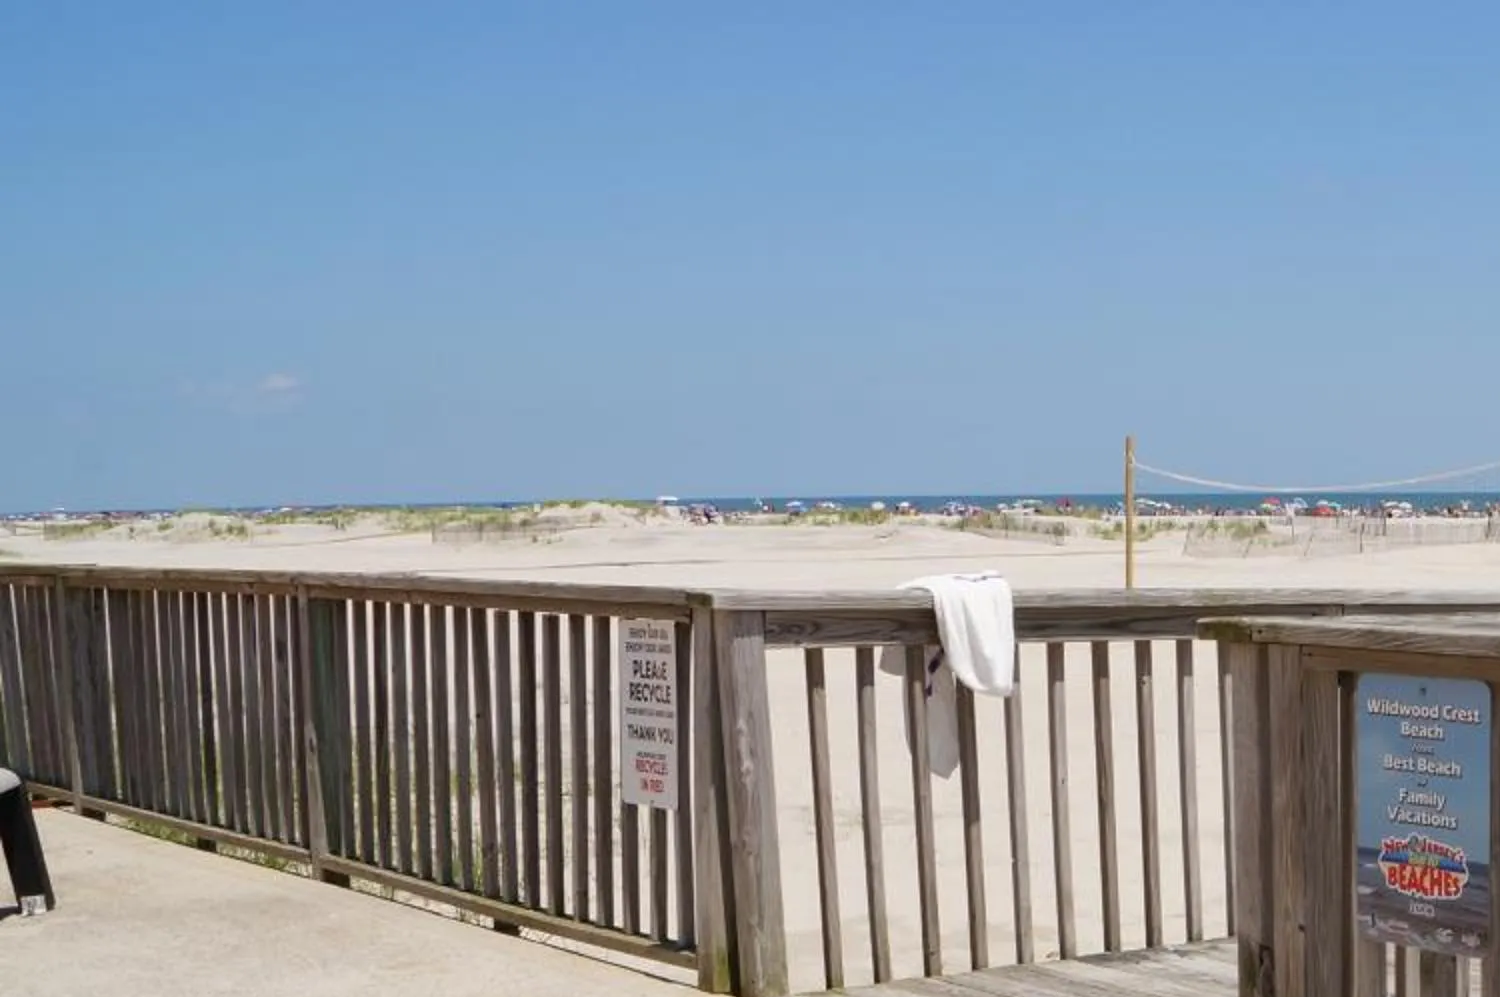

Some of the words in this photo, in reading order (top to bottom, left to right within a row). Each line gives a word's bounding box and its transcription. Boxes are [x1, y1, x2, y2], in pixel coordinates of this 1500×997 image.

[632, 659, 668, 680] PLEASE
[629, 681, 671, 704] RECYCLE
[1367, 699, 1440, 719] Wildwood
[1443, 705, 1480, 723] Crest
[627, 723, 657, 742] THANK
[1401, 721, 1444, 740] Beach
[1383, 753, 1415, 770] Best
[1417, 757, 1461, 776] Beach
[1399, 787, 1445, 811] Family
[1387, 804, 1457, 829] Vacations
[1387, 864, 1461, 898] BEACHES
